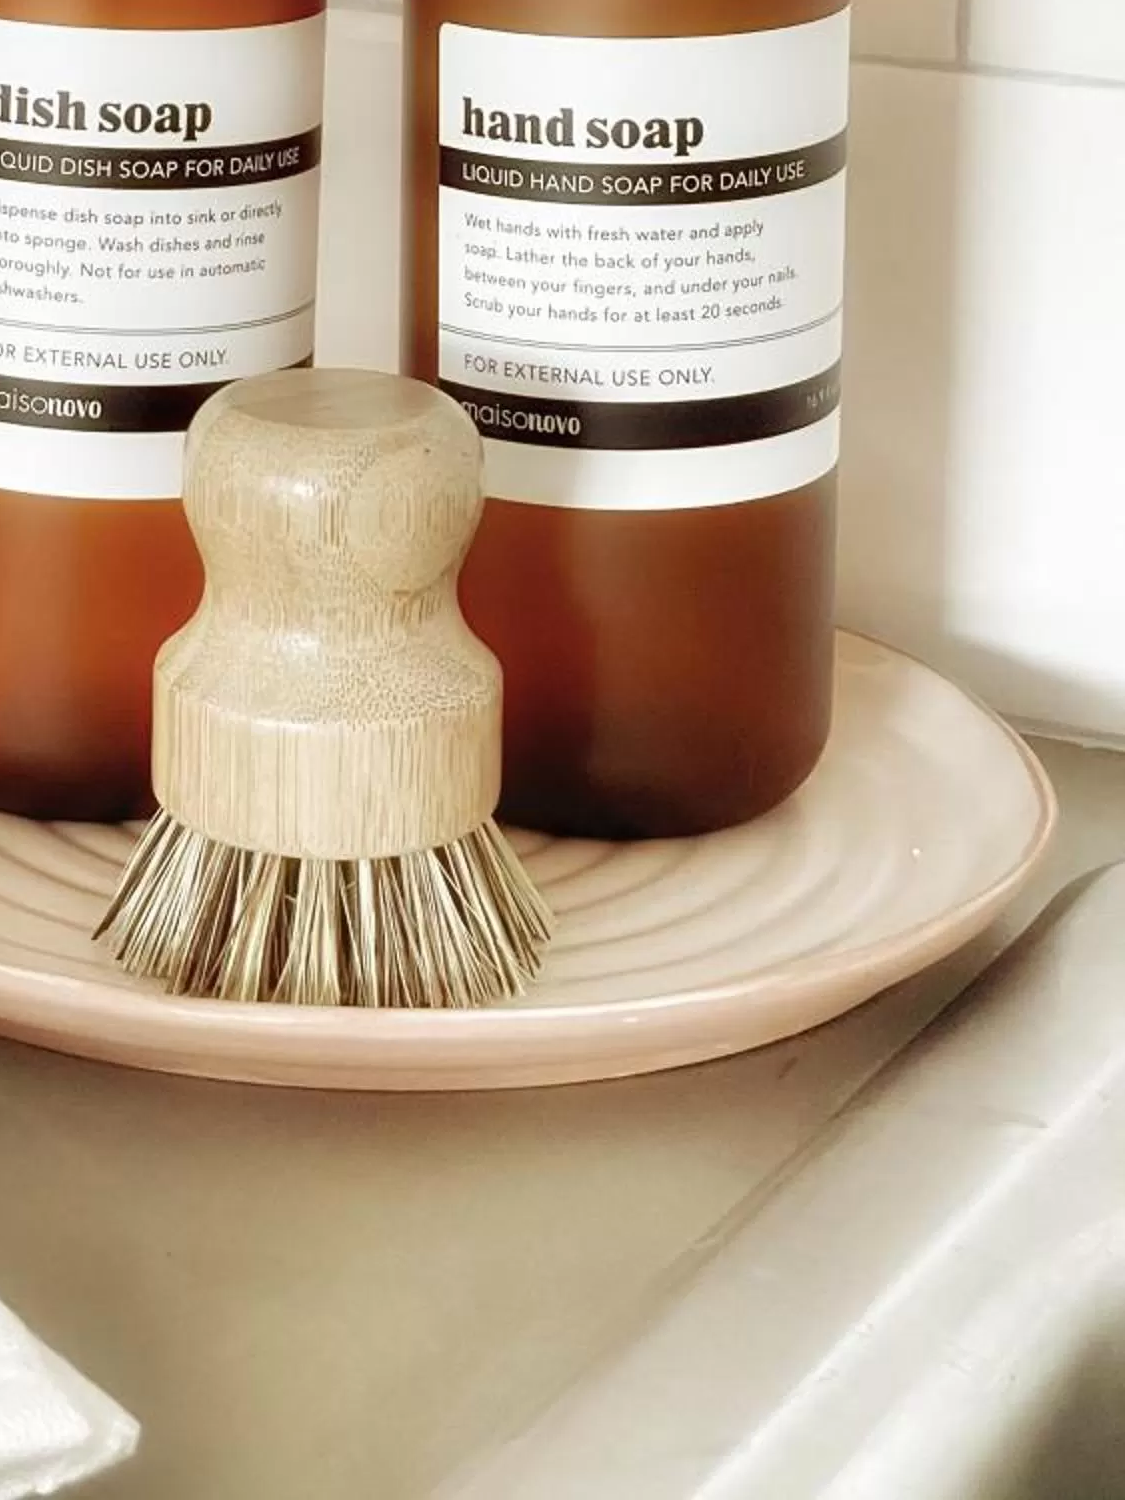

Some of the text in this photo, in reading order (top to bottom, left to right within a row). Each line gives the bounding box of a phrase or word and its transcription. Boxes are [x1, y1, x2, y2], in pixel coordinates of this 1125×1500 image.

[98, 100, 213, 141] soap
[462, 97, 704, 157] hand soap
[60, 155, 113, 178] DISH
[119, 159, 178, 180] SOAP
[185, 158, 225, 179] FOR
[230, 152, 274, 176] DAILY
[278, 147, 300, 168] USE
[462, 161, 806, 195] LIQUID HAND SOAP FOR DAILY USE
[64, 208, 98, 224] dish
[104, 212, 144, 227] soap
[150, 210, 182, 225] into
[187, 208, 216, 225] sink
[220, 211, 236, 222] or
[464, 212, 764, 241] Wet hands with fresh water and apply
[24, 233, 91, 252] sponge.
[98, 237, 143, 252] Wash
[149, 237, 200, 252] dishes
[205, 234, 232, 251] and
[235, 233, 265, 248] rinse
[80, 263, 111, 278] Not
[118, 263, 141, 280] for
[147, 266, 175, 279] use
[180, 263, 194, 278] in
[506, 246, 555, 265] Lather
[562, 251, 588, 267] the
[594, 252, 635, 269] back
[641, 252, 659, 269] of
[664, 255, 701, 272] your
[706, 248, 755, 265] hands,
[464, 266, 525, 289] between
[531, 280, 566, 295] your
[573, 278, 636, 298] fingers,
[644, 280, 675, 295] and
[680, 277, 727, 292] under
[732, 275, 763, 292] your
[464, 291, 503, 313] Scrub
[508, 303, 542, 319] your
[548, 303, 597, 322] hands
[603, 306, 627, 323] for
[634, 309, 651, 323] at
[656, 307, 696, 322] least
[701, 304, 720, 319] 20
[24, 346, 127, 370] EXTERNAL
[135, 351, 172, 369] USE
[464, 354, 715, 386] FOR EXTERNAL USE ONLY.
